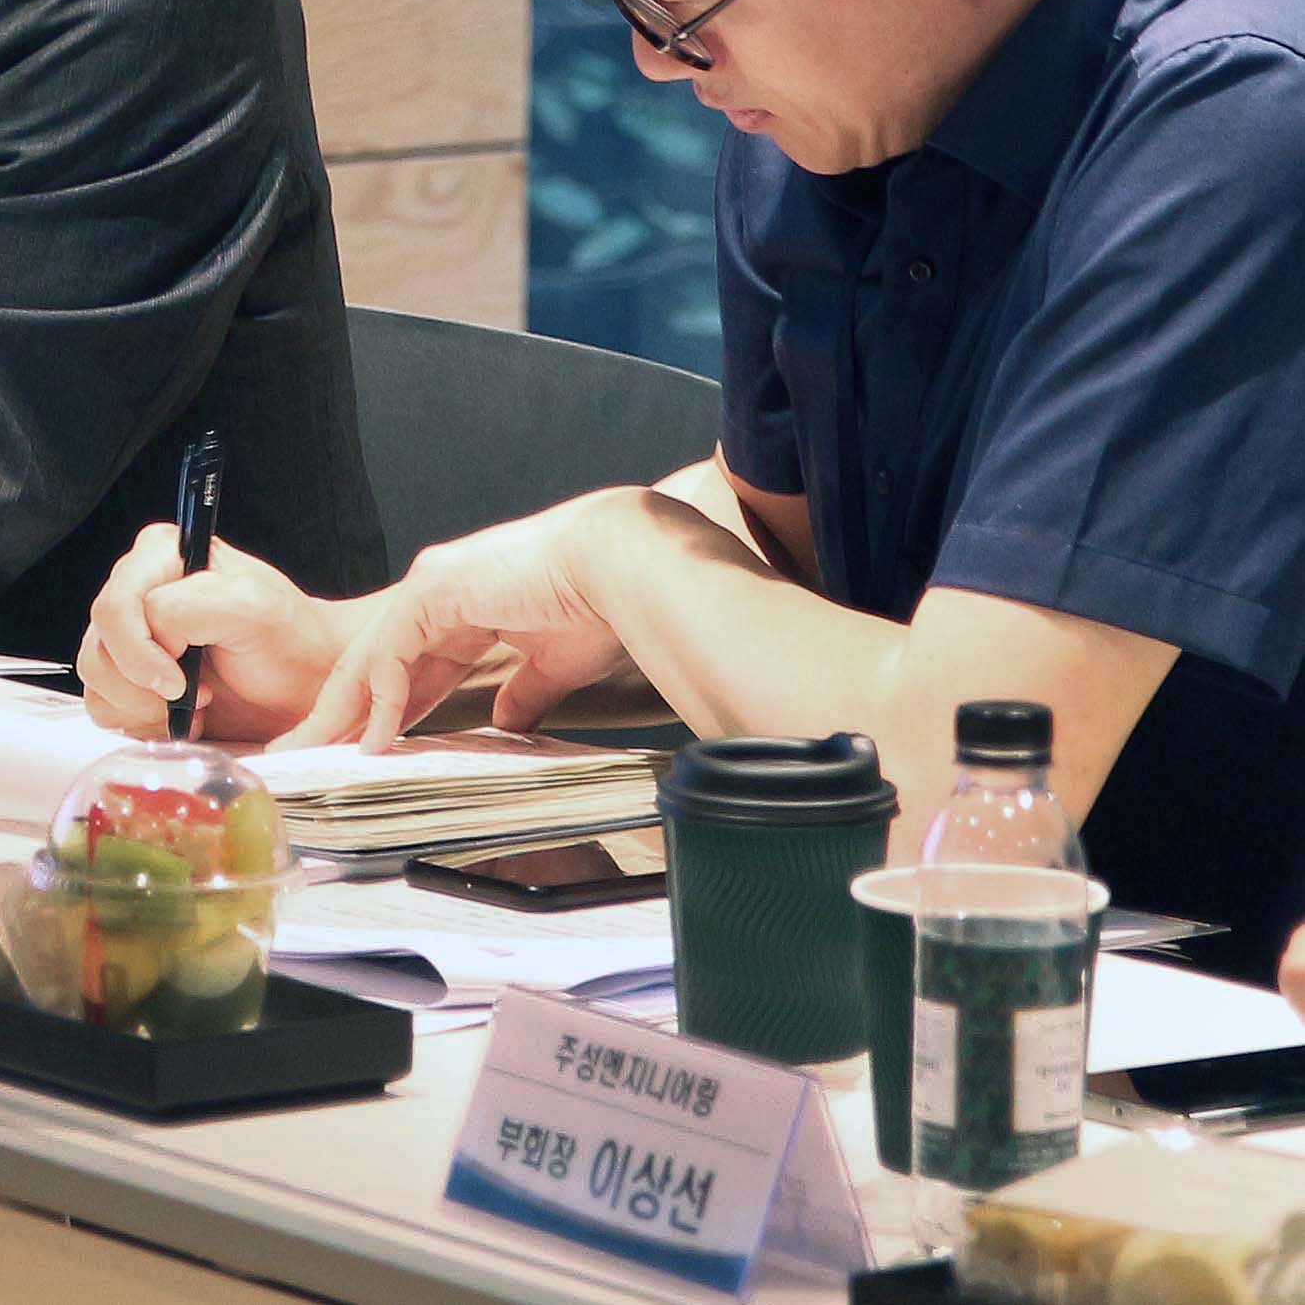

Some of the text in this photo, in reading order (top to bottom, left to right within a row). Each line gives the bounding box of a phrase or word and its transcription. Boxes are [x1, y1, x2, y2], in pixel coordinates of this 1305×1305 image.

[554, 1033, 720, 1118] 주성엔지니어링
[497, 1117, 718, 1236] 부회장 이상선
